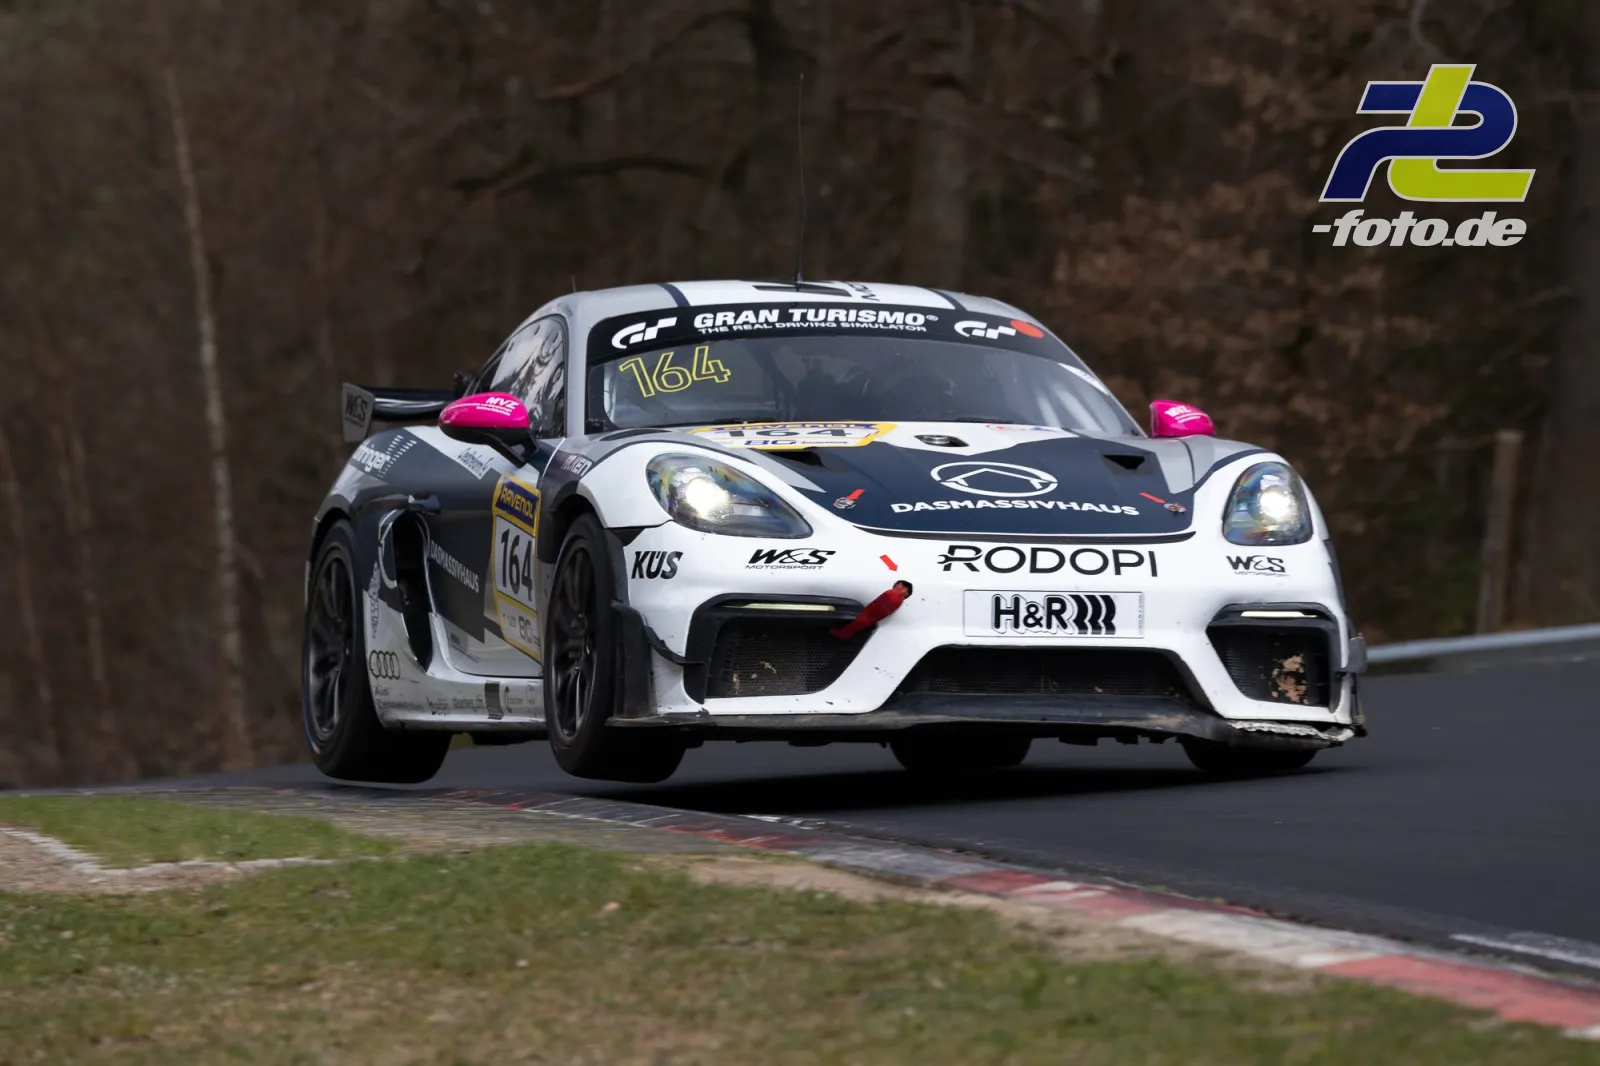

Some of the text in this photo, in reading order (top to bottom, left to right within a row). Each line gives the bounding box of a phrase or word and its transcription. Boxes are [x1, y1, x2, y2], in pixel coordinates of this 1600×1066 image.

[693, 309, 779, 329] GRAN
[698, 326, 729, 334] THE
[731, 324, 770, 332] REAL
[841, 322, 927, 332] SIMULATOR
[619, 345, 731, 397] 164
[486, 397, 519, 409] MVZ
[715, 429, 853, 437] 164
[500, 487, 534, 518] RAVENOL
[890, 500, 1140, 516] DASMASSIVHAUS
[430, 540, 479, 593] DASMASSIVHAUS
[500, 527, 533, 602] 164
[631, 551, 684, 579] KÜS
[748, 548, 836, 565] W&S
[937, 545, 1158, 577] RODOPI
[1226, 555, 1286, 573] W&S
[992, 594, 1074, 635] H&R
